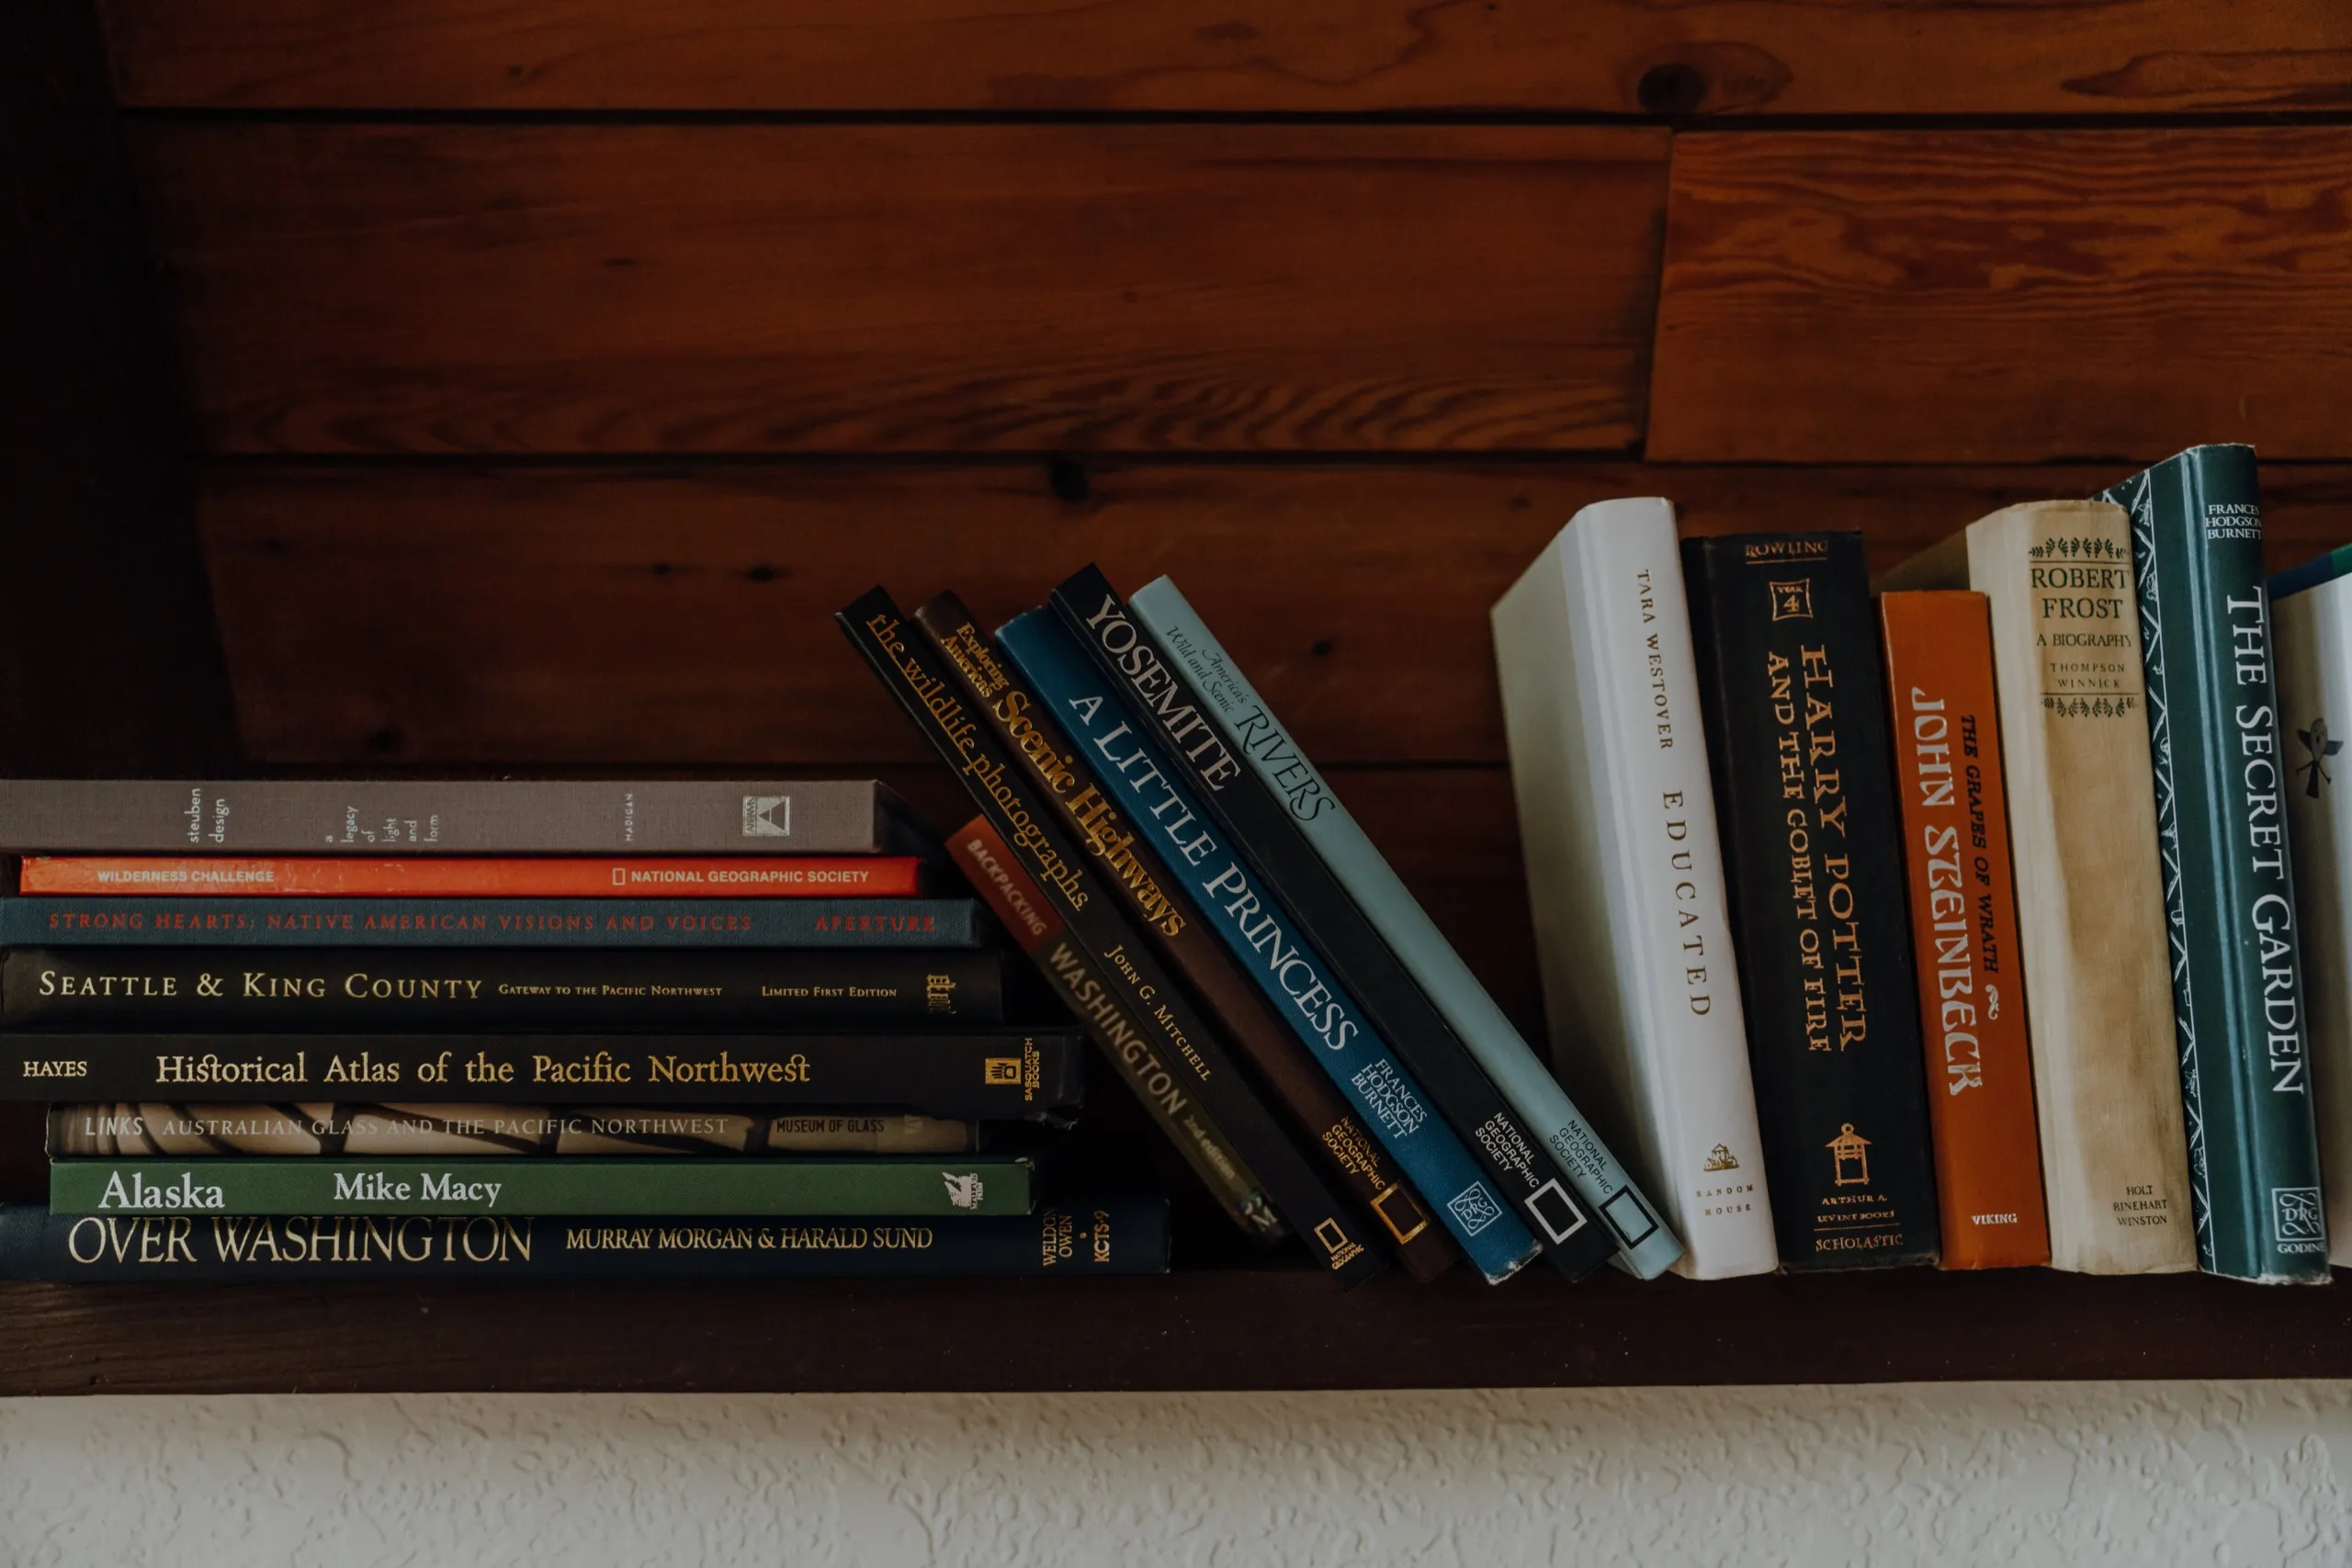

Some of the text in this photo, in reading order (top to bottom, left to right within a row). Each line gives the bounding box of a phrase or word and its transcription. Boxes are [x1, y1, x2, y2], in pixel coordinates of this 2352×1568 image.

[2205, 515, 2262, 527] HODGSON
[2208, 503, 2260, 515] FRANCES
[1746, 540, 1828, 558] ROWLING
[2207, 528, 2261, 540] BURNETT
[2030, 568, 2130, 589] ROBERT
[1782, 594, 1801, 613] 4
[2042, 597, 2123, 618] FROST
[956, 621, 1010, 691] Exploring
[1636, 569, 1674, 750] TARA WESTOVER
[2036, 634, 2133, 648] A BIOGRAPHY
[1166, 626, 1235, 713] Wild and Scenic
[1202, 649, 1250, 705] America's
[2050, 662, 2125, 672] THOMPSON
[2057, 678, 2123, 688] WINNICK
[1085, 593, 1242, 792] YOSEMITE
[865, 614, 1090, 912] the wildlife photographs
[1235, 705, 1336, 822] RIVERS
[184, 787, 201, 843] steuben
[208, 797, 230, 843] design
[340, 805, 359, 843] legacy
[382, 817, 401, 842] light
[403, 819, 417, 842] and
[424, 815, 439, 842] form
[625, 793, 634, 842] MADIGAN
[992, 690, 1186, 938] Scenic Highways
[324, 834, 334, 843] a
[361, 829, 376, 843] of
[1767, 651, 1832, 1052] AND THE GOBLET OF FIRE
[1801, 644, 1868, 1052] HARRY POTTER
[1961, 714, 1999, 975] THE GRAPES OF WRATH
[2226, 585, 2305, 1095] THE SECRET GARDEN
[97, 871, 275, 883] WILDERNESS CHALLENGE
[631, 870, 869, 883] NATIONAL GEOGRAPHIC SOCIETY
[966, 839, 1047, 937] BACKPACKING
[1069, 695, 1359, 1051] A LITTLE PRINCESS
[1911, 686, 1984, 1097] JOHN STEINBECK
[49, 913, 144, 930] STRONG
[266, 914, 354, 930] NATIVE
[364, 914, 487, 931] AMERICAN
[499, 915, 594, 931] VISIONS
[605, 916, 654, 931] AND
[666, 916, 752, 931] VOICES
[815, 916, 936, 932] APERTURE
[1663, 790, 1712, 1017] EDUCATED
[196, 974, 224, 998] &
[555, 986, 571, 996] TO
[575, 986, 598, 996] THE
[1049, 942, 1188, 1115] WASHINGTON
[1103, 943, 1212, 1082] JOHN G. MITCHELL
[23, 1059, 87, 1077] HAYES
[156, 1051, 811, 1084] Historical Atlas of the Pacific Northwest
[1023, 1037, 1034, 1102] SASQUATCH
[1030, 1050, 1040, 1089] BOOKS
[1351, 1072, 1408, 1140] BURNETT
[1362, 1064, 1420, 1135] HODGSON
[1374, 1058, 1428, 1122] FRANCES
[85, 1117, 730, 1136] LINKS AUSTRALIAN GLASS AND THE PACIFIC NORTHWEST
[776, 1119, 885, 1134] MUSEUM OF GLASS
[1340, 1116, 1382, 1168] NATIONAL
[1493, 1111, 1535, 1165] NATIONAL
[1567, 1120, 1608, 1173] NATIONAL
[1322, 1131, 1361, 1176] SOCIETY
[1330, 1124, 1386, 1191] GEOGRAPHIC
[1475, 1127, 1514, 1173] SOCIETY
[1484, 1120, 1541, 1189] GEOGRAPHIC
[1549, 1134, 1587, 1179] SOCIETY
[1558, 1127, 1613, 1196] GEOGRAPHIC
[97, 1170, 503, 1209] Alaska Mike Macy
[1696, 1183, 1754, 1198] RANDOM
[1705, 1203, 1752, 1216] HOUSE
[1821, 1194, 1874, 1205] ARTHUR
[2113, 1199, 2168, 1211] RINEHART
[2126, 1184, 2154, 1196] HOLT
[1058, 1214, 1073, 1258] OWEN
[1816, 1209, 1895, 1224] LEVINE BOOKS
[1971, 1213, 2018, 1225] VIKING
[2117, 1214, 2168, 1226] WINSTON
[68, 1215, 535, 1263] OVER WASHINGTON
[566, 1227, 934, 1250] MURRAY MORGAN & HARALD SUND
[1043, 1208, 1057, 1267] WELDON
[1815, 1233, 1904, 1252] SCHOLASTIC
